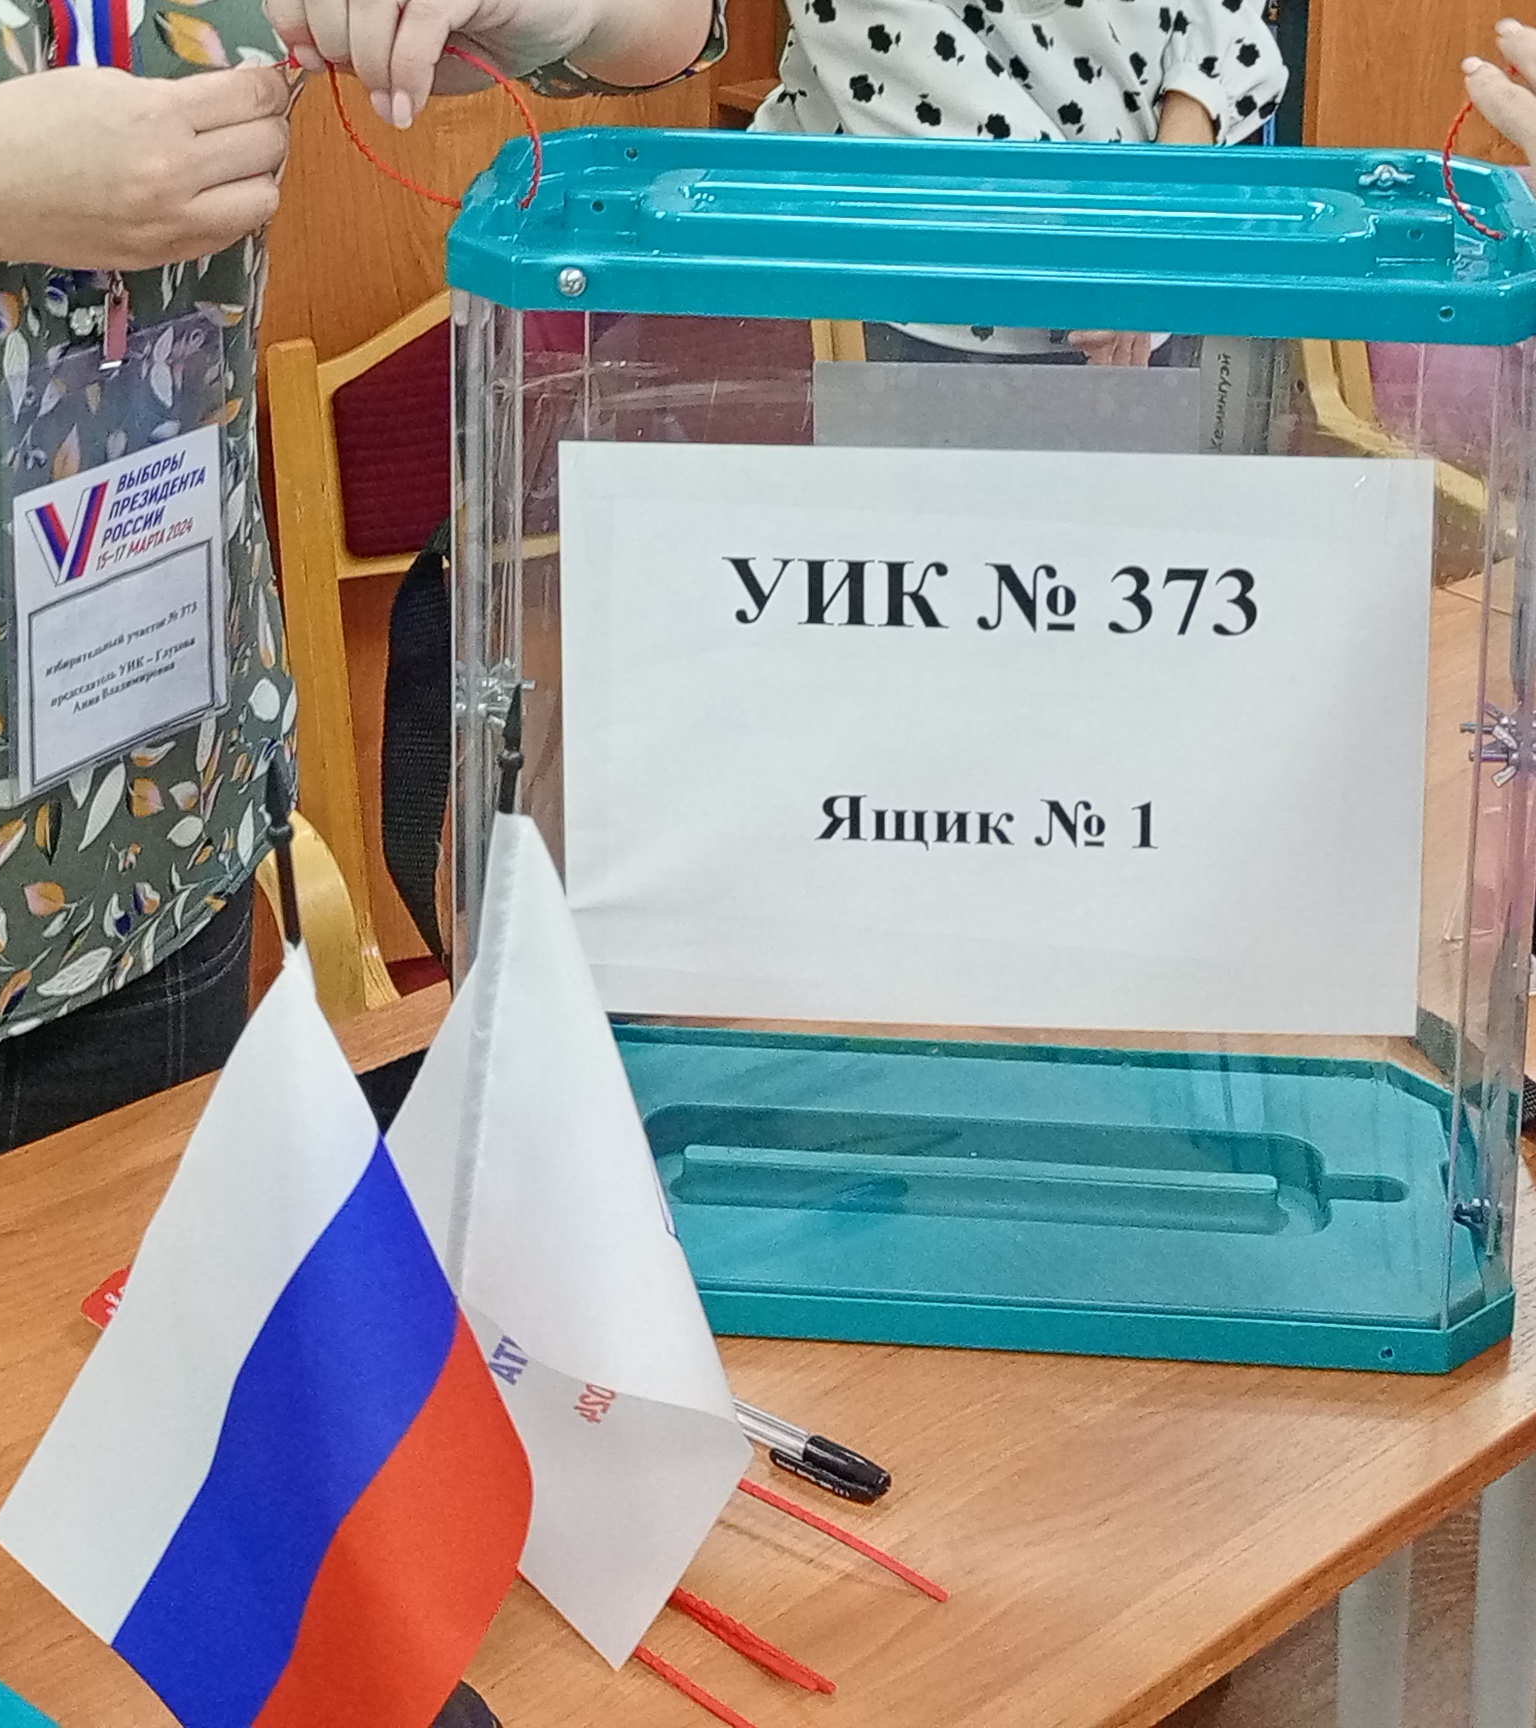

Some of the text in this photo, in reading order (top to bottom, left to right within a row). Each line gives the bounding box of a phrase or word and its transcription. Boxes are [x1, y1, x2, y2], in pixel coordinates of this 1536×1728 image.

[107, 465, 207, 522] ПРЕЗИДЕНТА
[116, 449, 187, 495] ВЫБОРЫ
[100, 505, 166, 548] РОССИИ
[126, 528, 166, 562] МАРТА
[165, 516, 195, 546] 2024
[722, 556, 1260, 638] УИК № 373
[118, 655, 145, 677] УИК
[72, 694, 101, 714] Анна
[815, 793, 1160, 854] Ящик № 1
